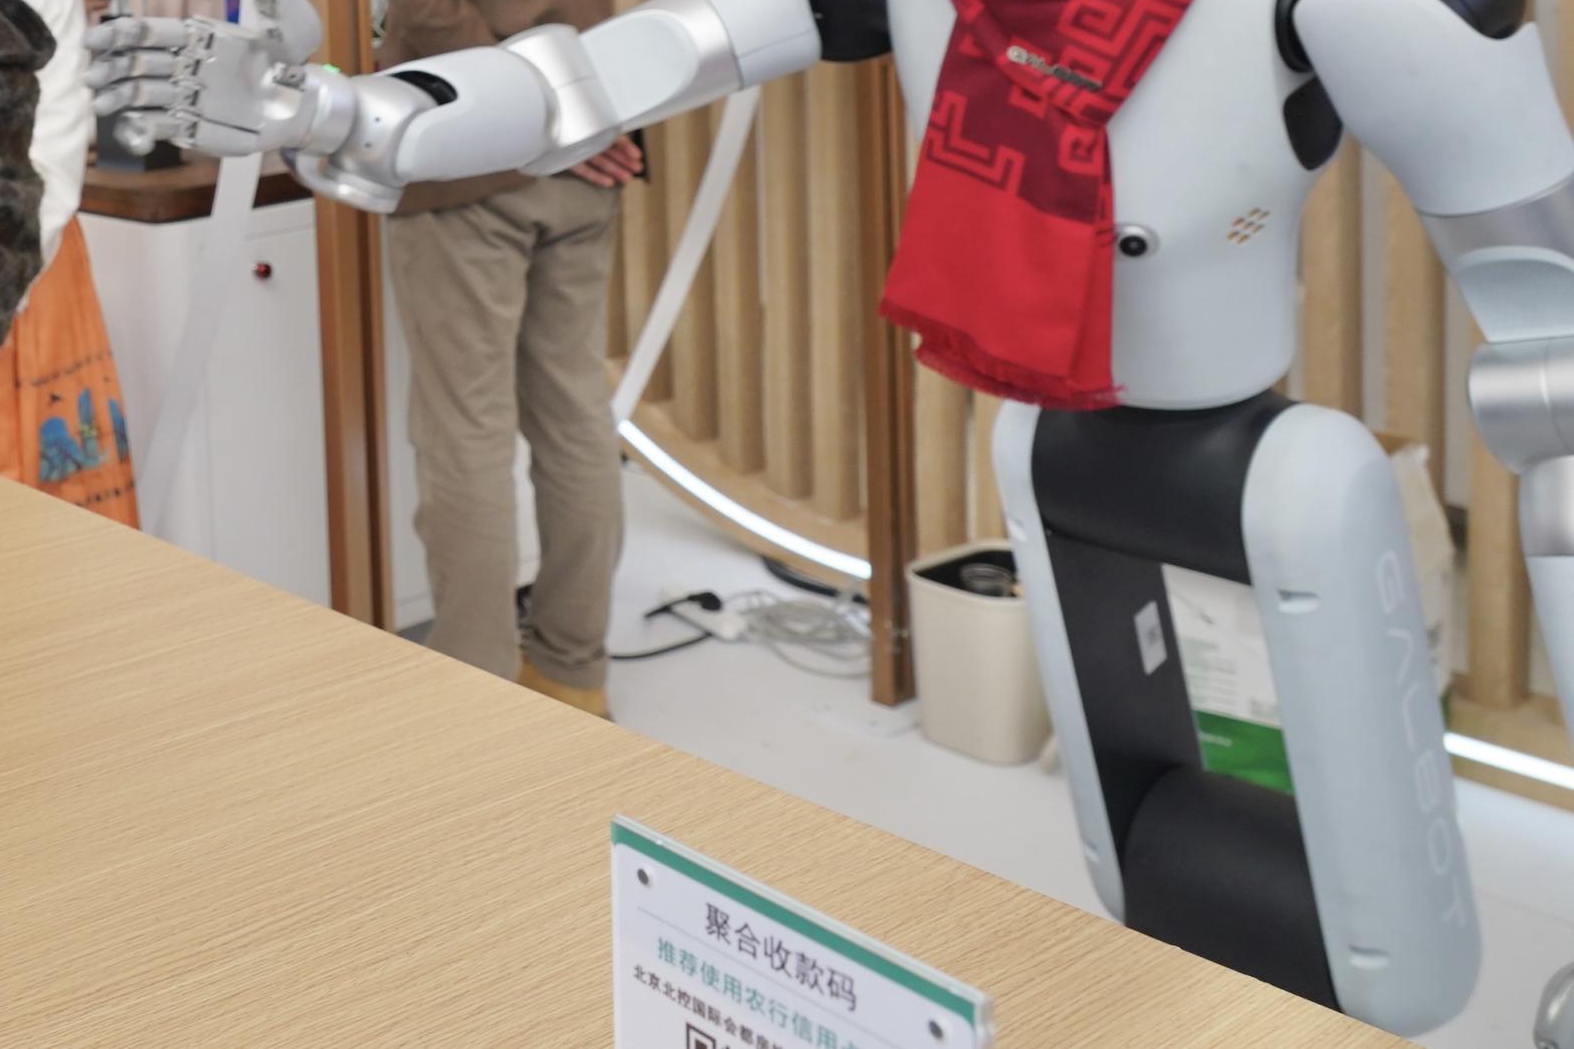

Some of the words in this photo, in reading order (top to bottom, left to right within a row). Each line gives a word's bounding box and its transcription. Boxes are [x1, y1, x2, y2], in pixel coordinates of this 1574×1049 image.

[704, 902, 859, 1013] 聚合收款码
